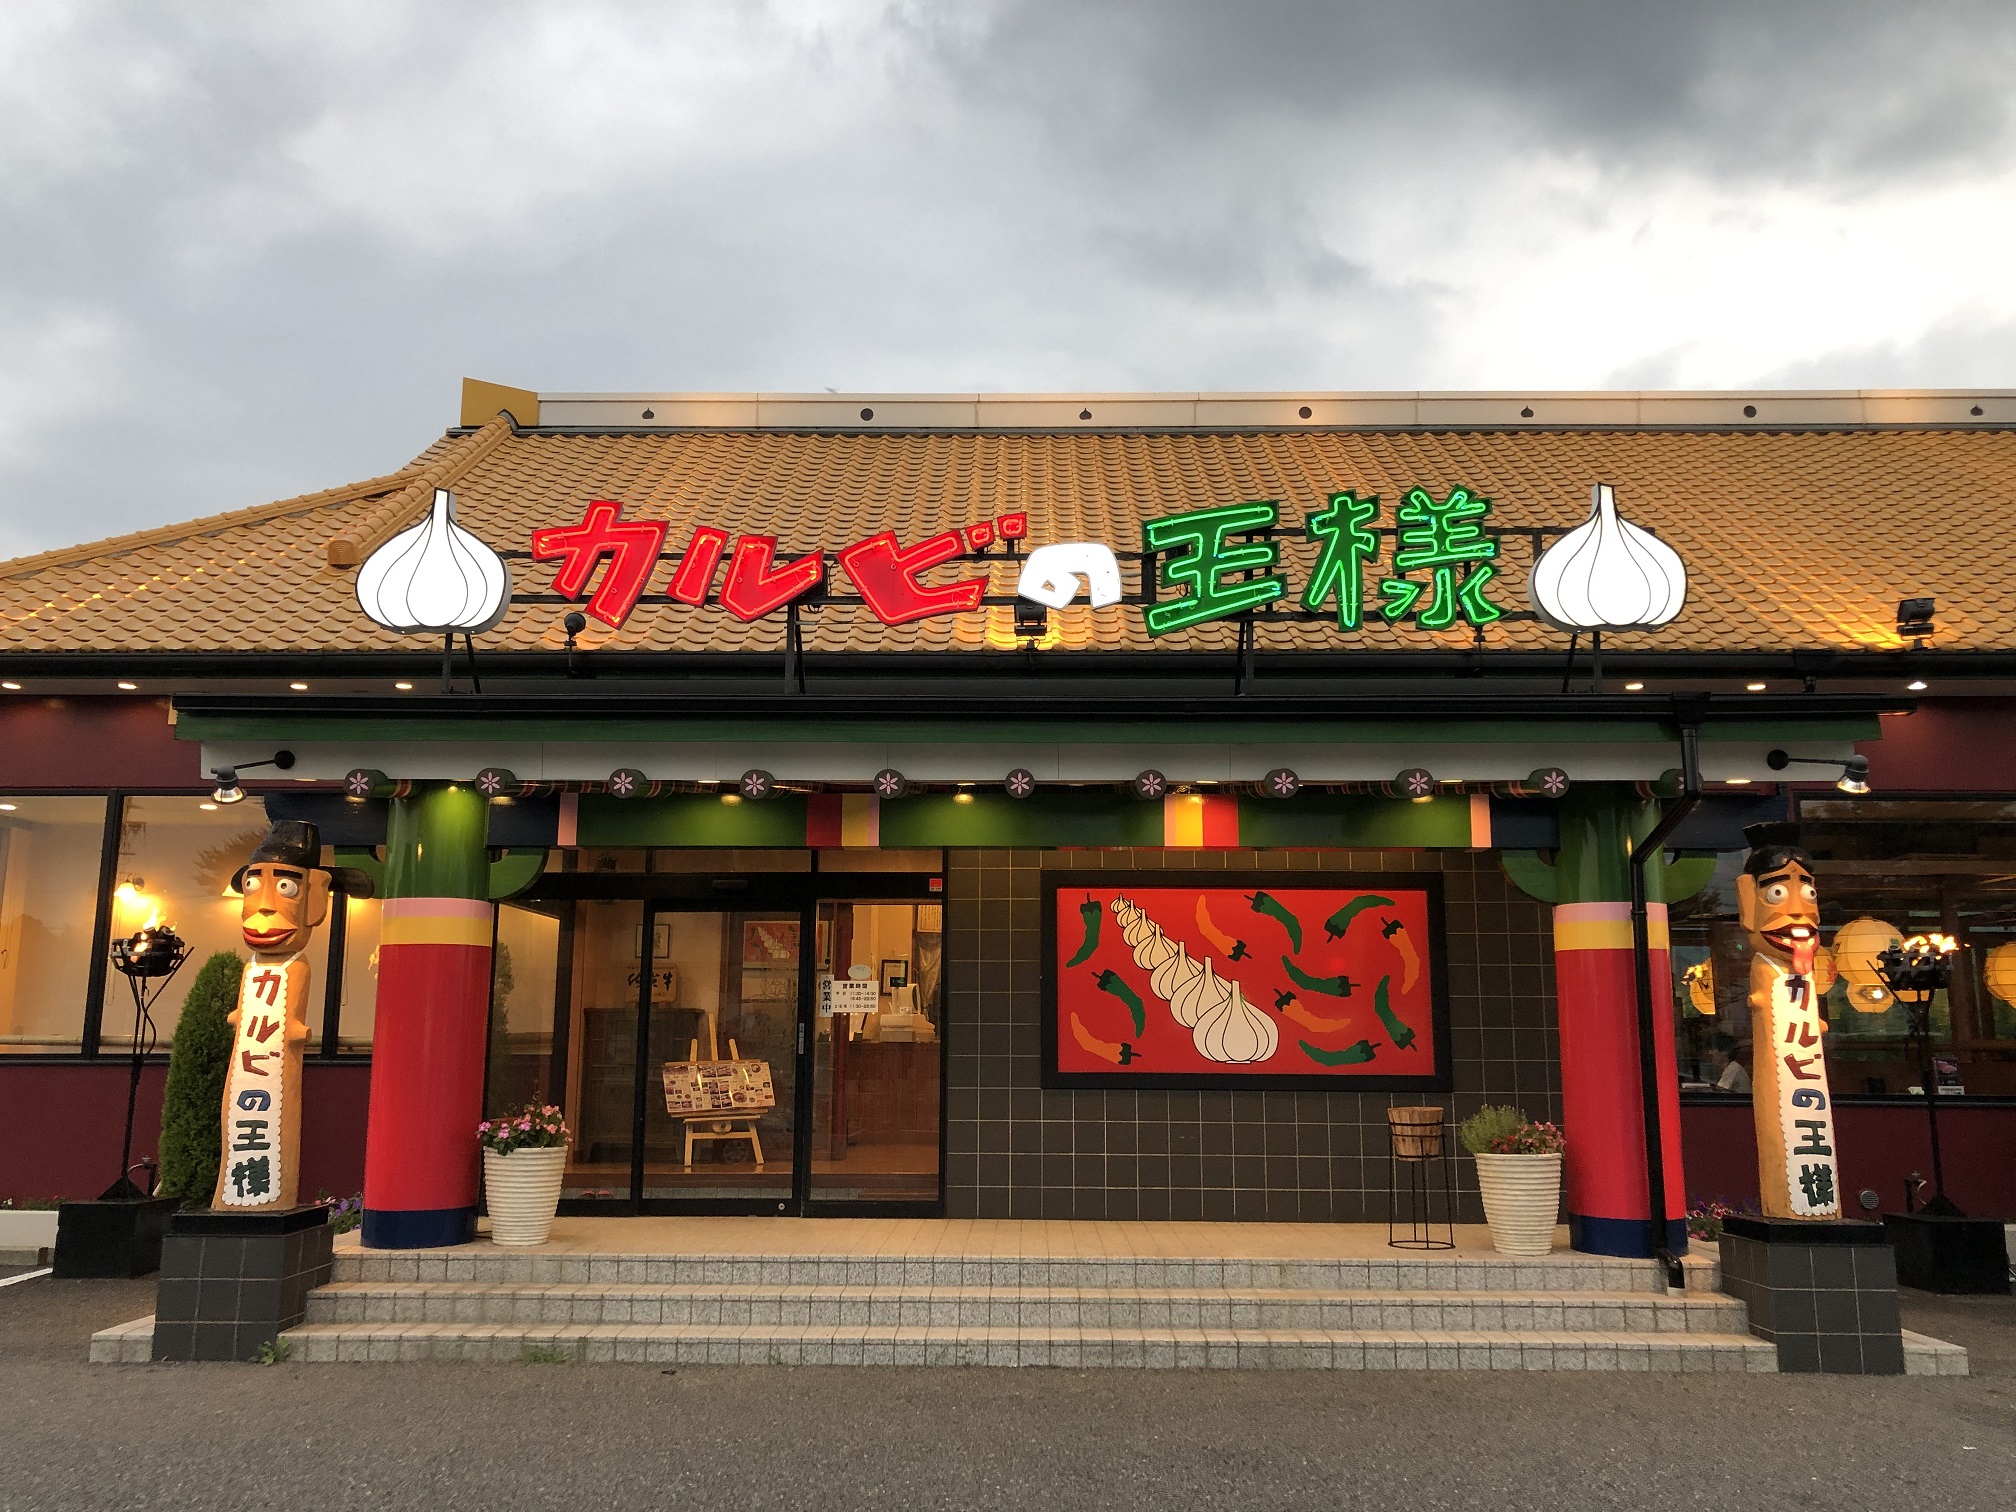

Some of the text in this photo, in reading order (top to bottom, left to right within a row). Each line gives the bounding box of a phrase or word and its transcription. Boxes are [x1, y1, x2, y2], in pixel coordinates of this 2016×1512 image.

[532, 484, 1505, 637] カルビの王様
[231, 969, 281, 1197] カルビの王様
[1783, 975, 1835, 1207] カルビの王様
